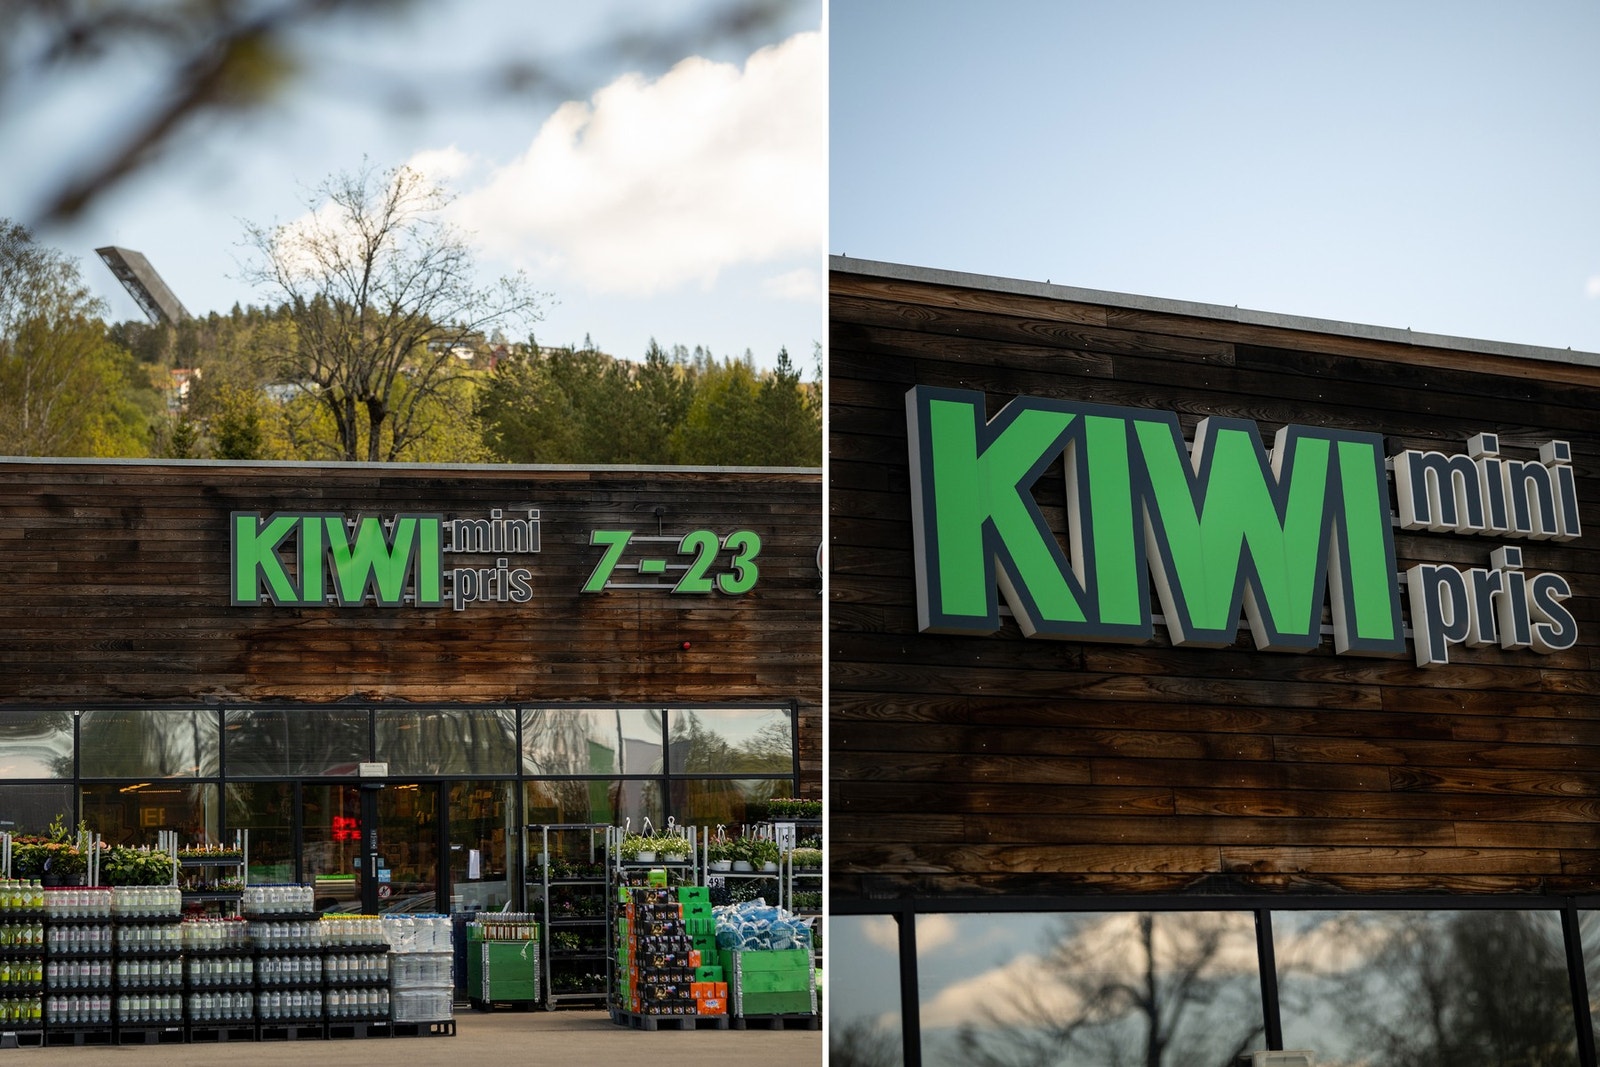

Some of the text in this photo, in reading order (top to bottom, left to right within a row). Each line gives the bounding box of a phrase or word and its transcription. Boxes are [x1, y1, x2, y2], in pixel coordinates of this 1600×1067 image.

[452, 508, 541, 552] mini
[908, 386, 1404, 656] KIWI
[1397, 432, 1582, 541] mini
[231, 511, 443, 607] KIWI
[452, 557, 534, 611] pris
[1408, 545, 1579, 668] pris
